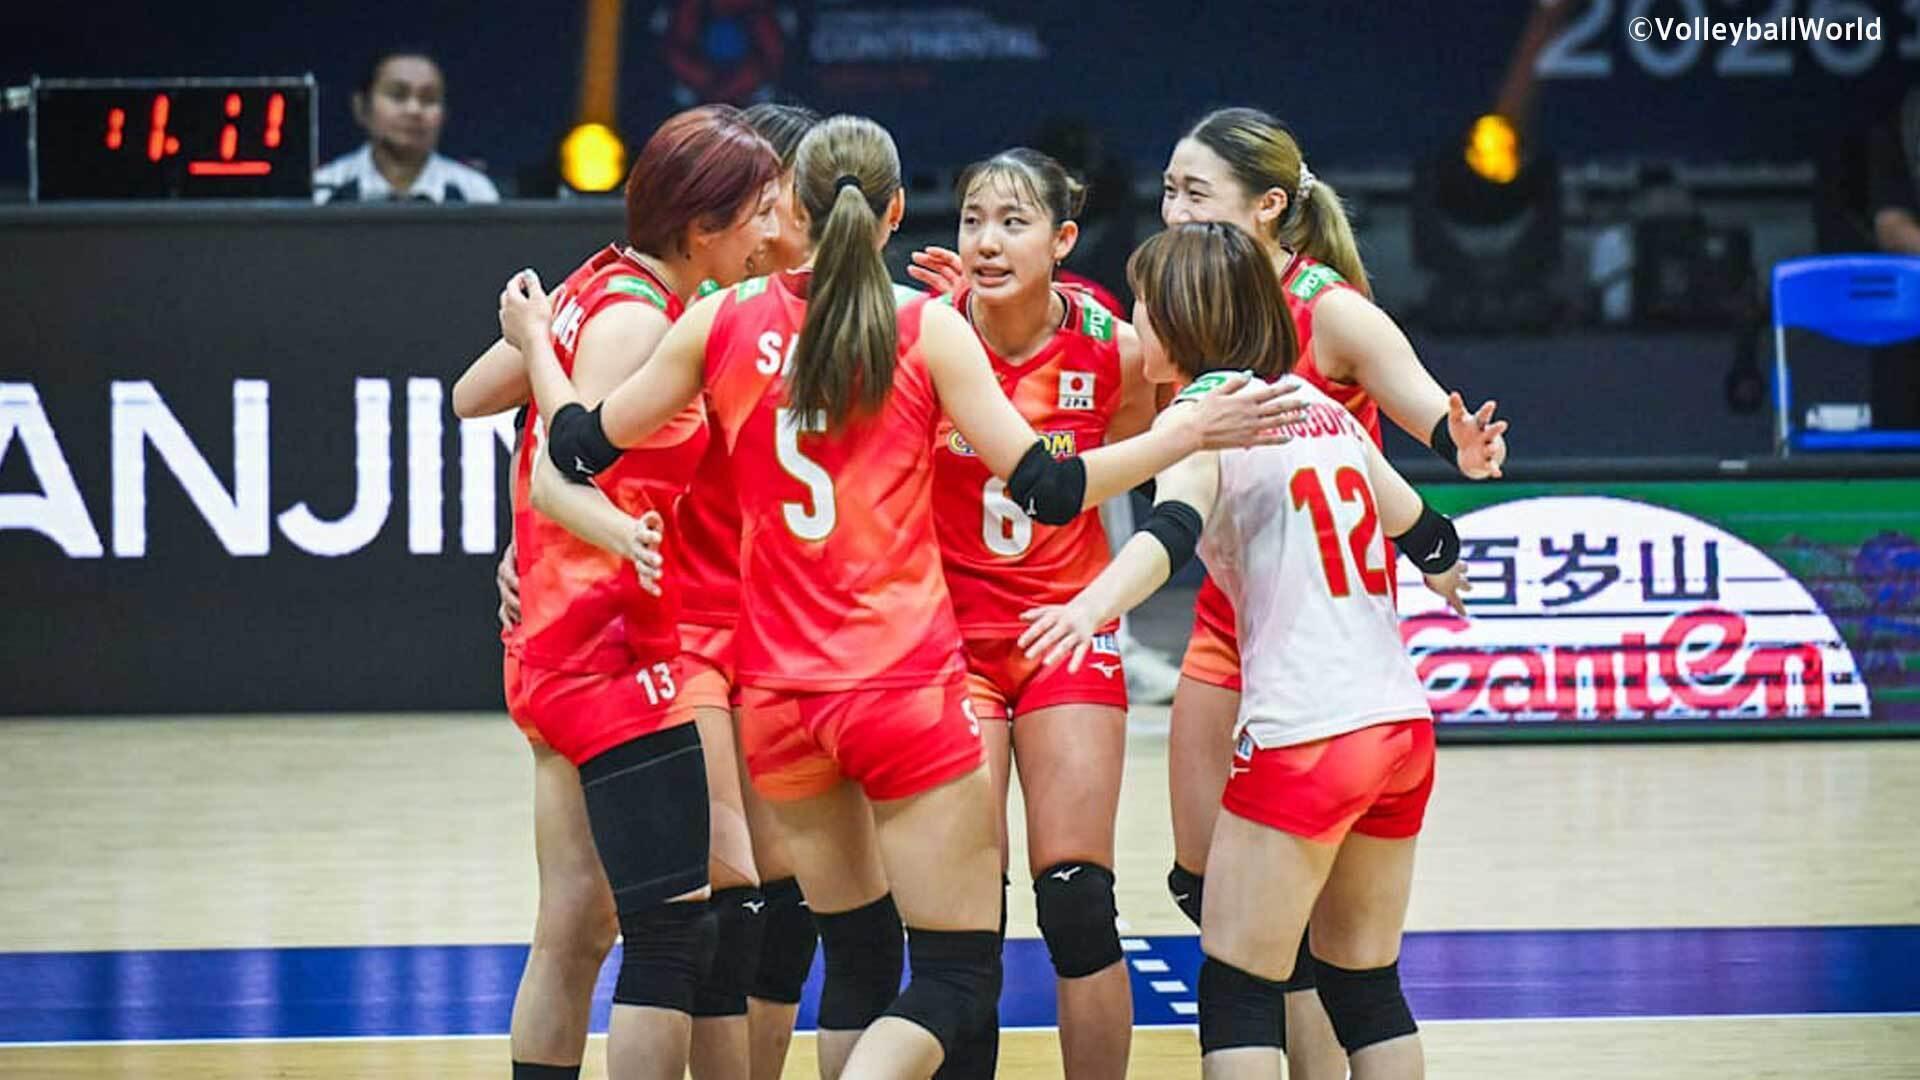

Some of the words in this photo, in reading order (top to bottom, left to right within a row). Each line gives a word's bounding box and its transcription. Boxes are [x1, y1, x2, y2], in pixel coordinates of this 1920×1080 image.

[776, 409, 837, 542] 5
[982, 477, 1033, 556] 6
[1289, 466, 1393, 598] 12
[1460, 533, 1721, 607] 百岁山
[637, 663, 676, 704] 13
